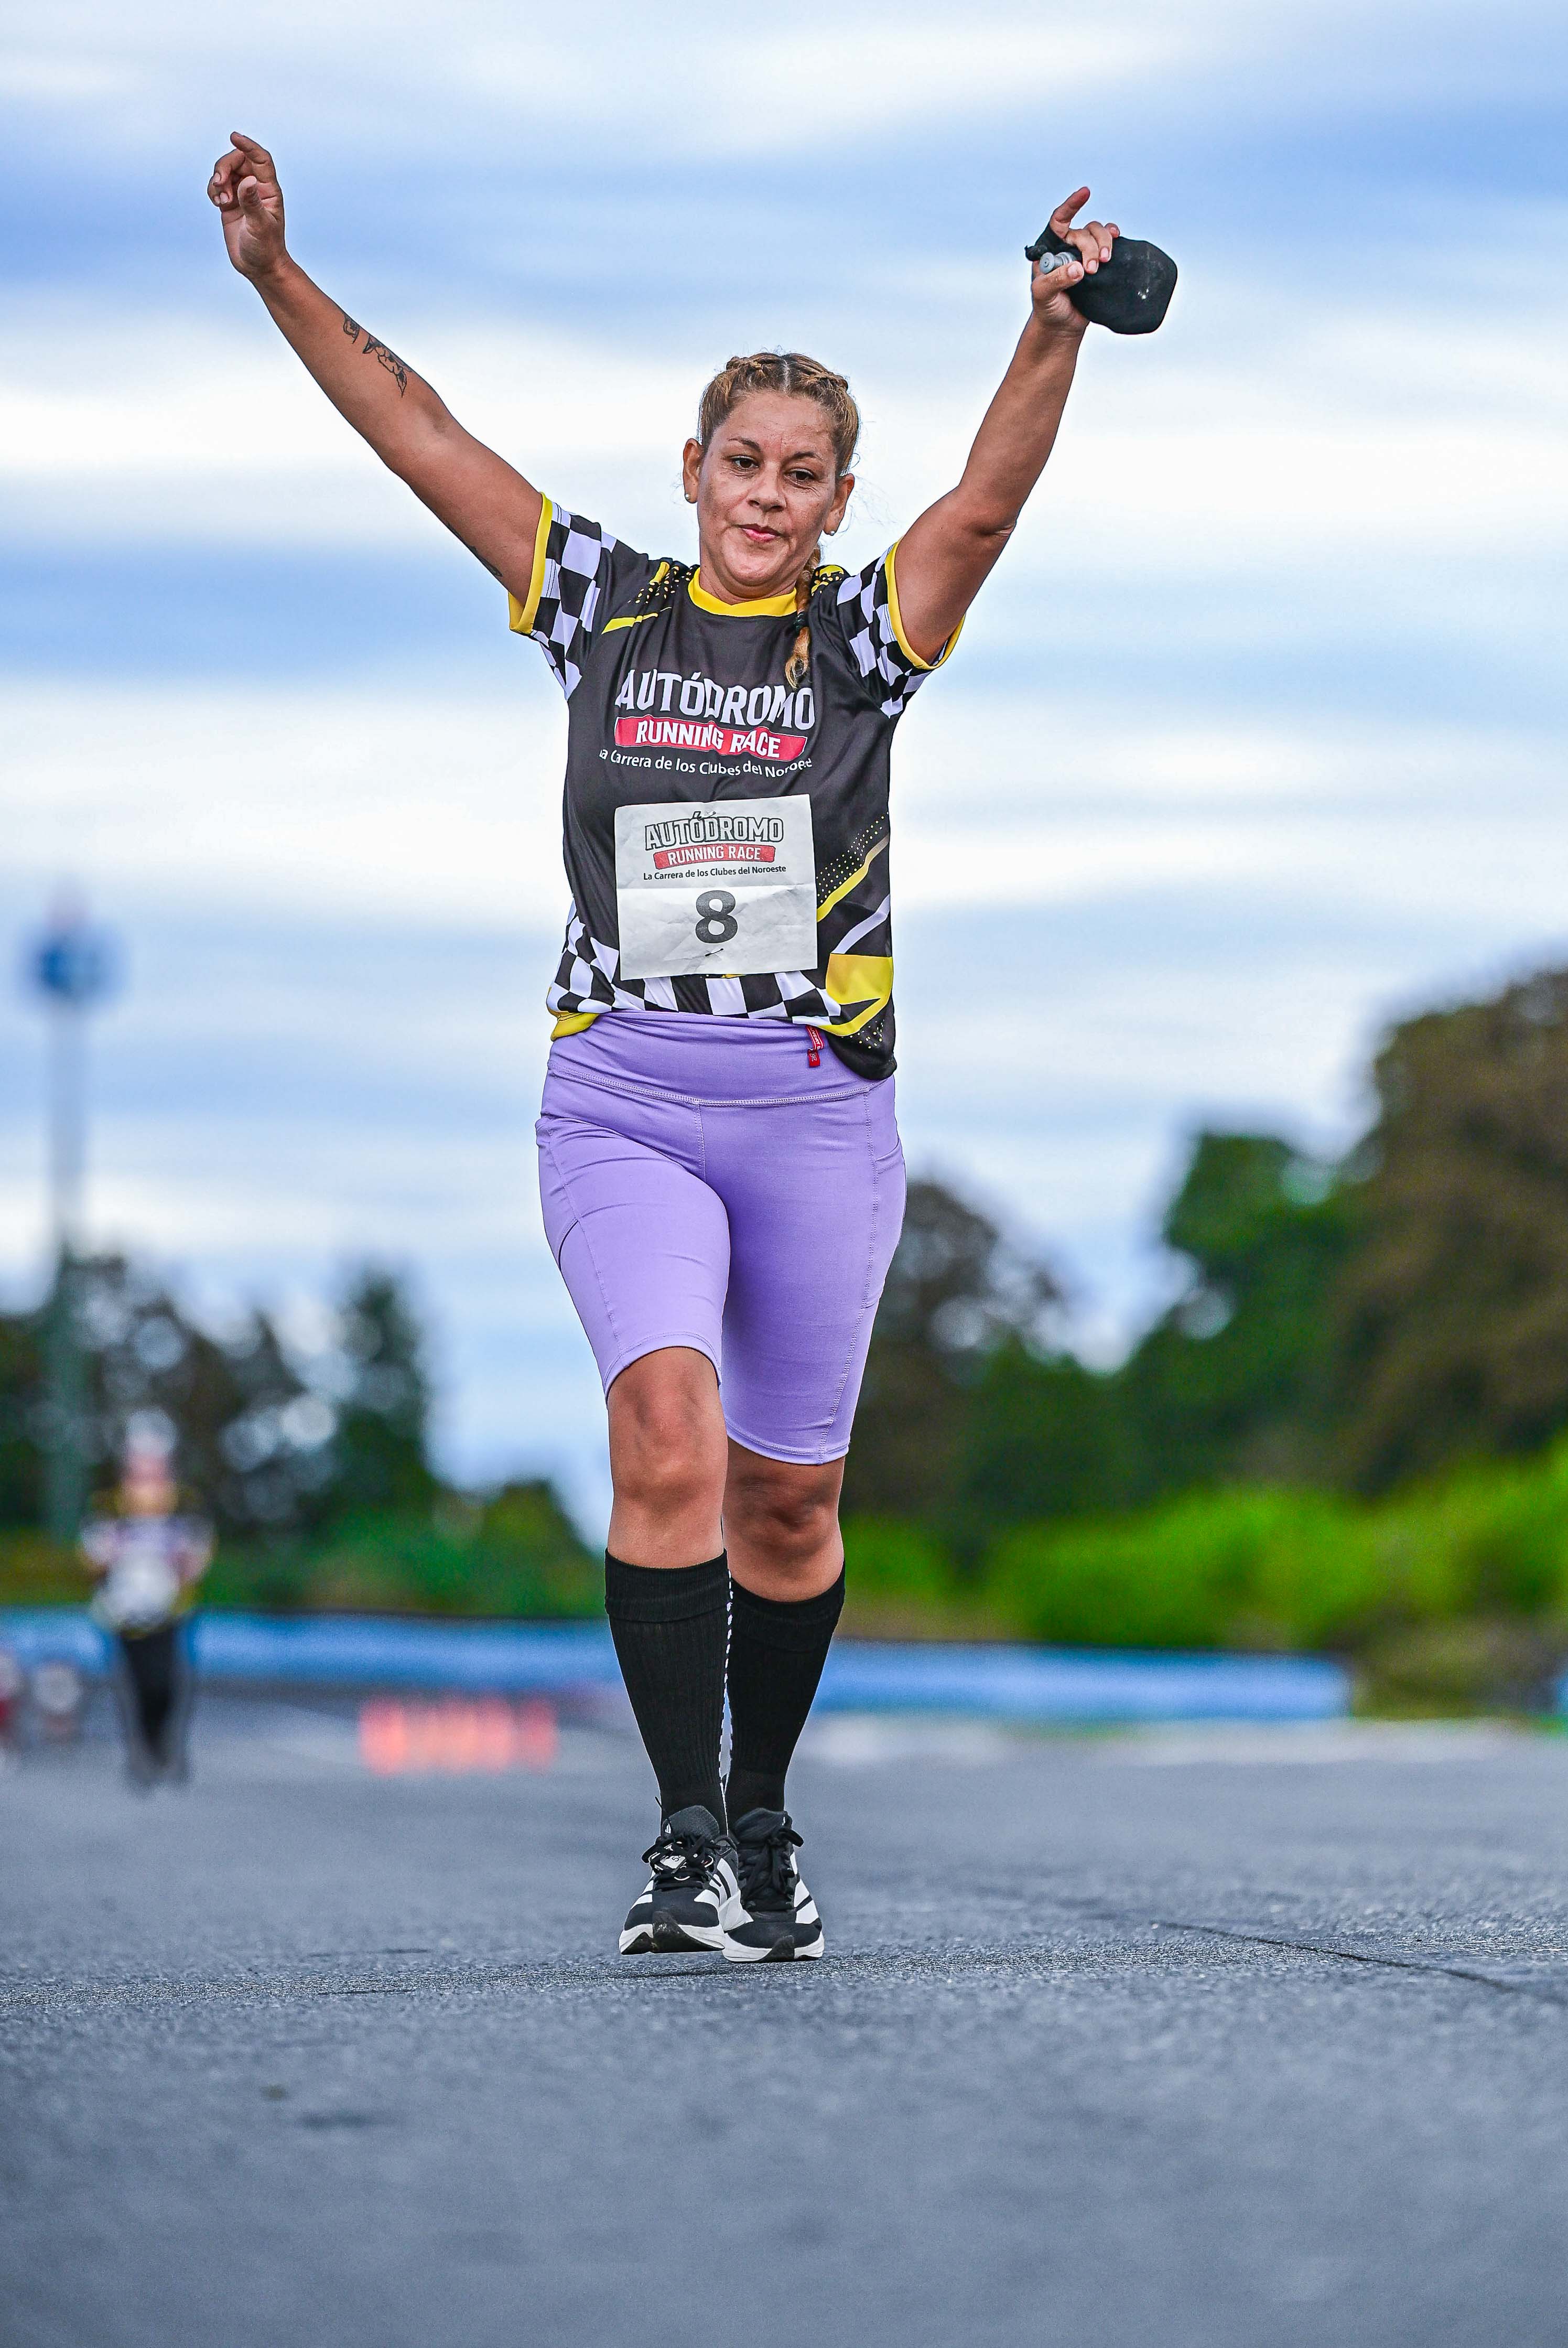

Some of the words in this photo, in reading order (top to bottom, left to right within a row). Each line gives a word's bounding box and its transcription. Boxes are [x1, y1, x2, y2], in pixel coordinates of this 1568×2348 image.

[615, 669, 815, 730] AUTÓDROMO
[635, 719, 724, 750] RUNNING
[729, 729, 781, 758] RACE
[611, 750, 652, 768] Carrera
[655, 756, 673, 770] de
[676, 758, 696, 773] los
[699, 761, 741, 776] Clubes
[742, 760, 763, 775] del
[645, 811, 784, 851] AUTÓDROMO
[667, 846, 724, 866] RUNNING
[728, 845, 761, 860] RACE
[710, 867, 737, 876] Clubes
[695, 890, 738, 944] 8
